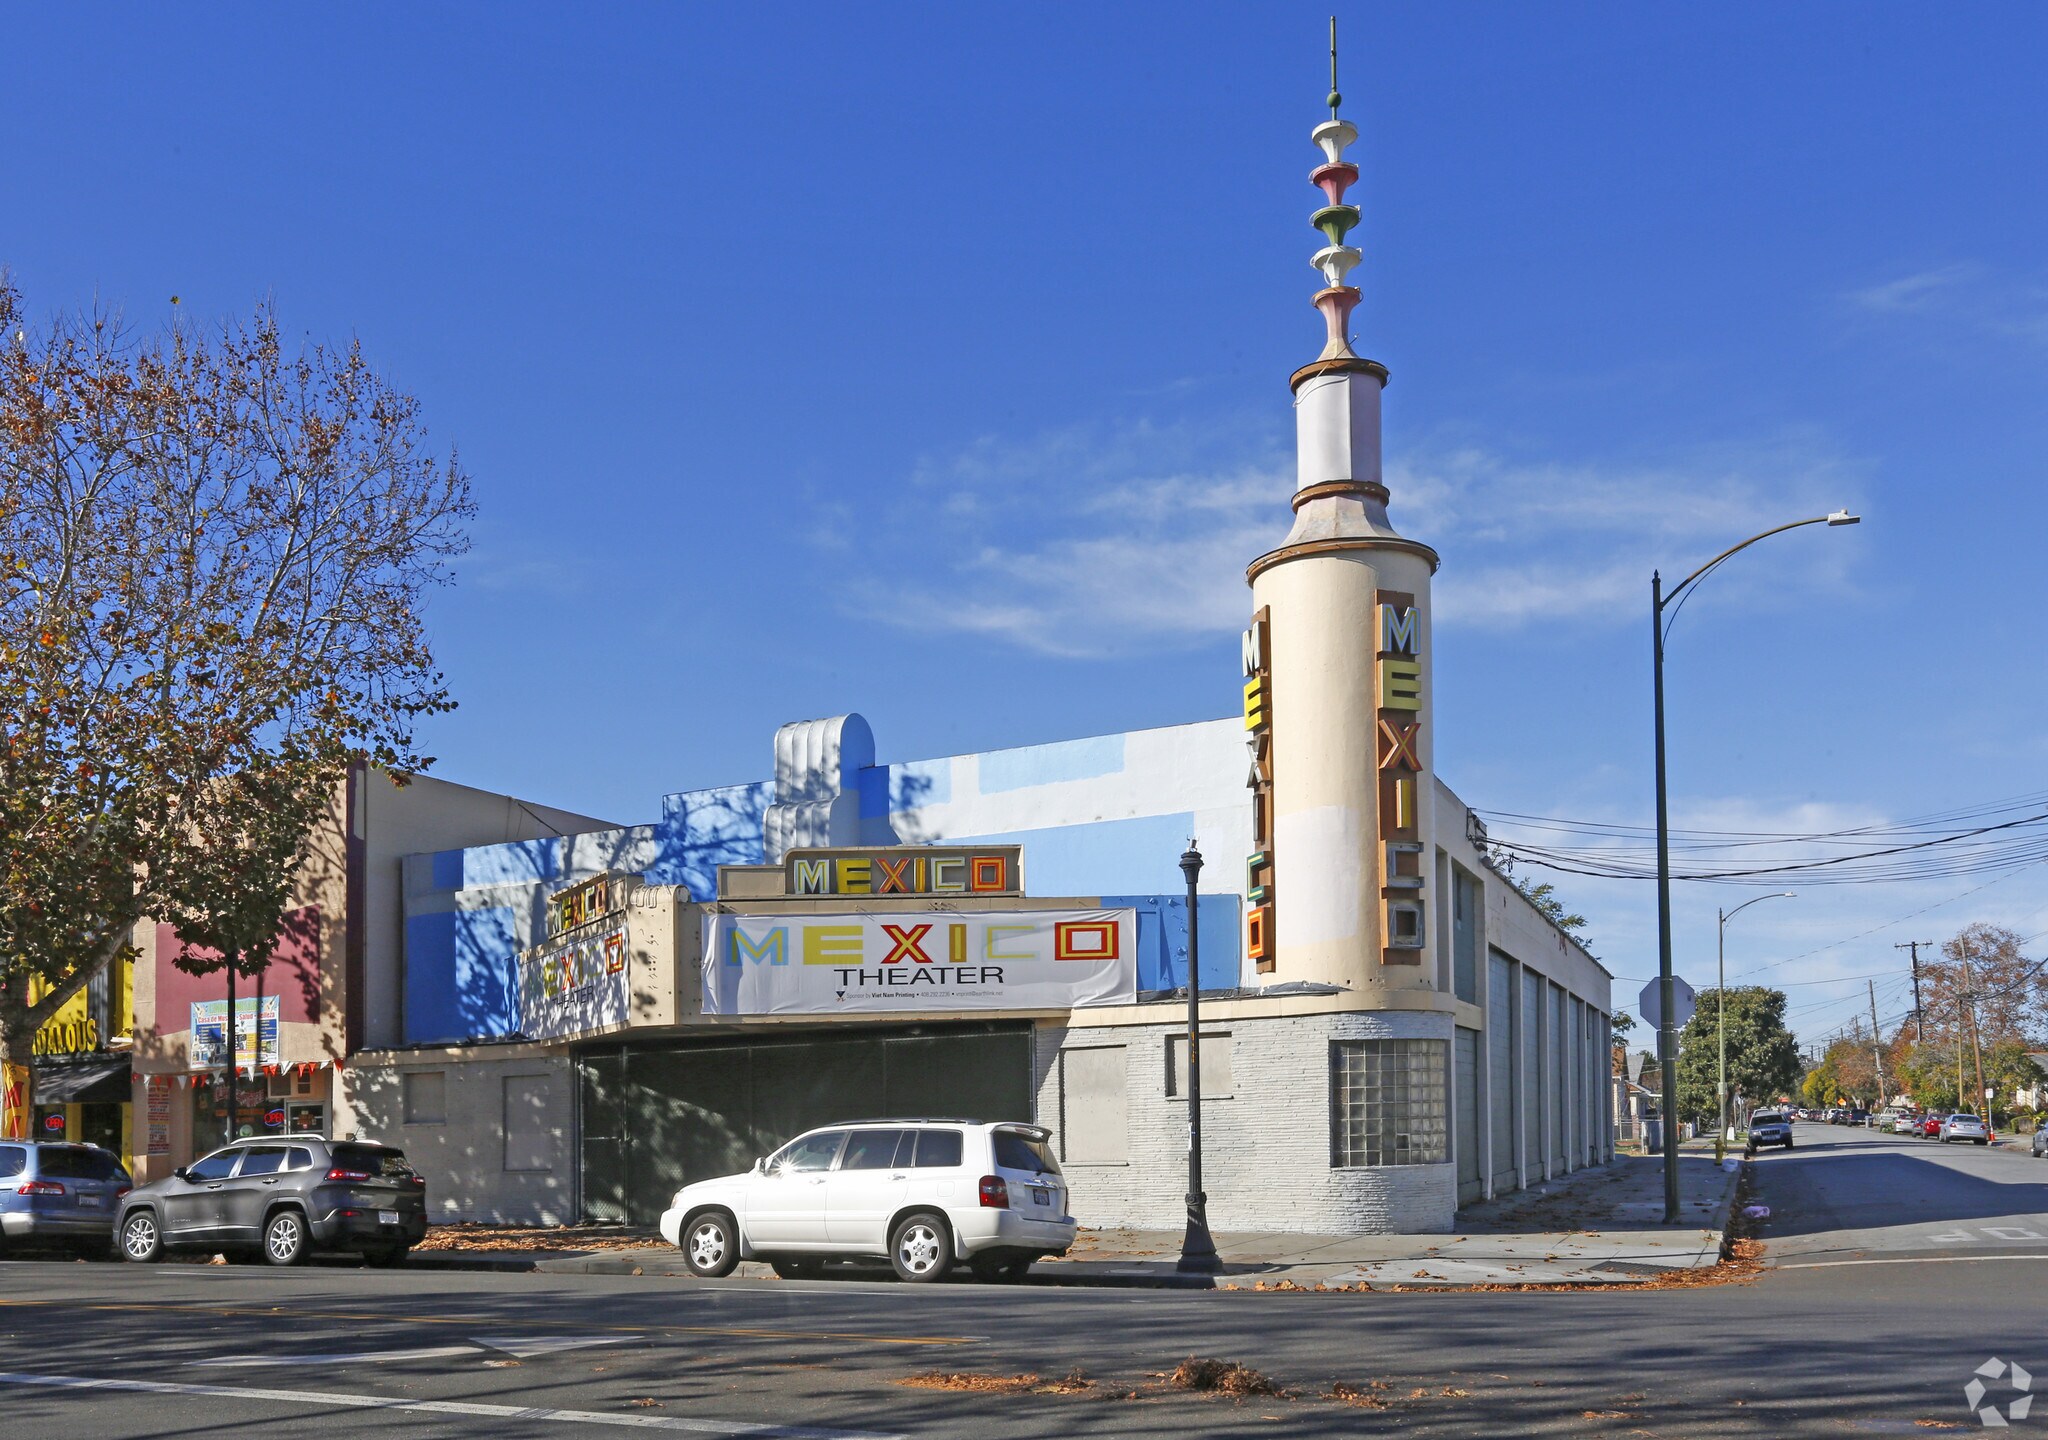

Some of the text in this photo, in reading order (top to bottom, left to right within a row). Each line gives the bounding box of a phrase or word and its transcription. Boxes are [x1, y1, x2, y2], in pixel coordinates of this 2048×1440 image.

[1242, 620, 1270, 960] MEXICO
[1379, 603, 1425, 950] MEXICO
[794, 856, 1007, 894] MEXICO
[552, 880, 606, 935] MEXICO
[725, 920, 1120, 967] MEXICO
[833, 966, 1004, 986] THEATER
[552, 985, 594, 1009] THEATER
[895, 991, 915, 999] Printing
[45, 1117, 64, 1129] OPEN
[264, 1112, 285, 1123] OPEN
